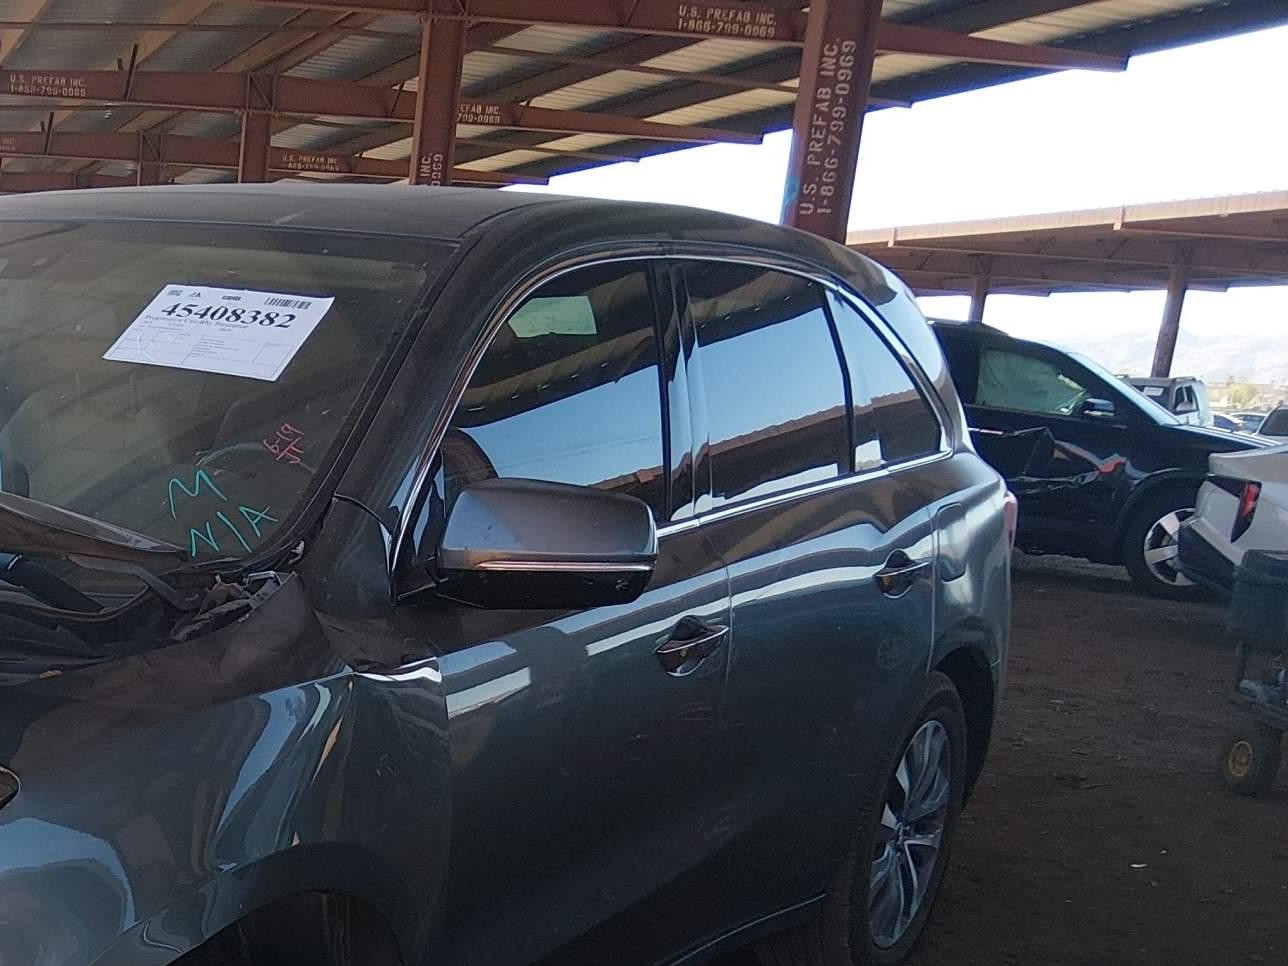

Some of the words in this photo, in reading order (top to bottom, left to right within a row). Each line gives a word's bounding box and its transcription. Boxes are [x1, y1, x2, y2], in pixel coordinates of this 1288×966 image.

[678, 18, 776, 37] 1-866-799-0969
[679, 5, 701, 19] U.S.
[706, 7, 751, 22] PREFAB
[755, 11, 777, 26] INC.
[819, 37, 841, 77] INC.
[456, 113, 501, 124] 799-0969
[460, 103, 482, 114] EFAB
[806, 86, 832, 166] PREFAB
[816, 40, 857, 214] 1-866-799-0969
[420, 152, 433, 177] INC.
[799, 177, 819, 215] U.S.
[161, 302, 296, 329] 45408382
[168, 468, 228, 520] M
[190, 505, 279, 558] N/A
